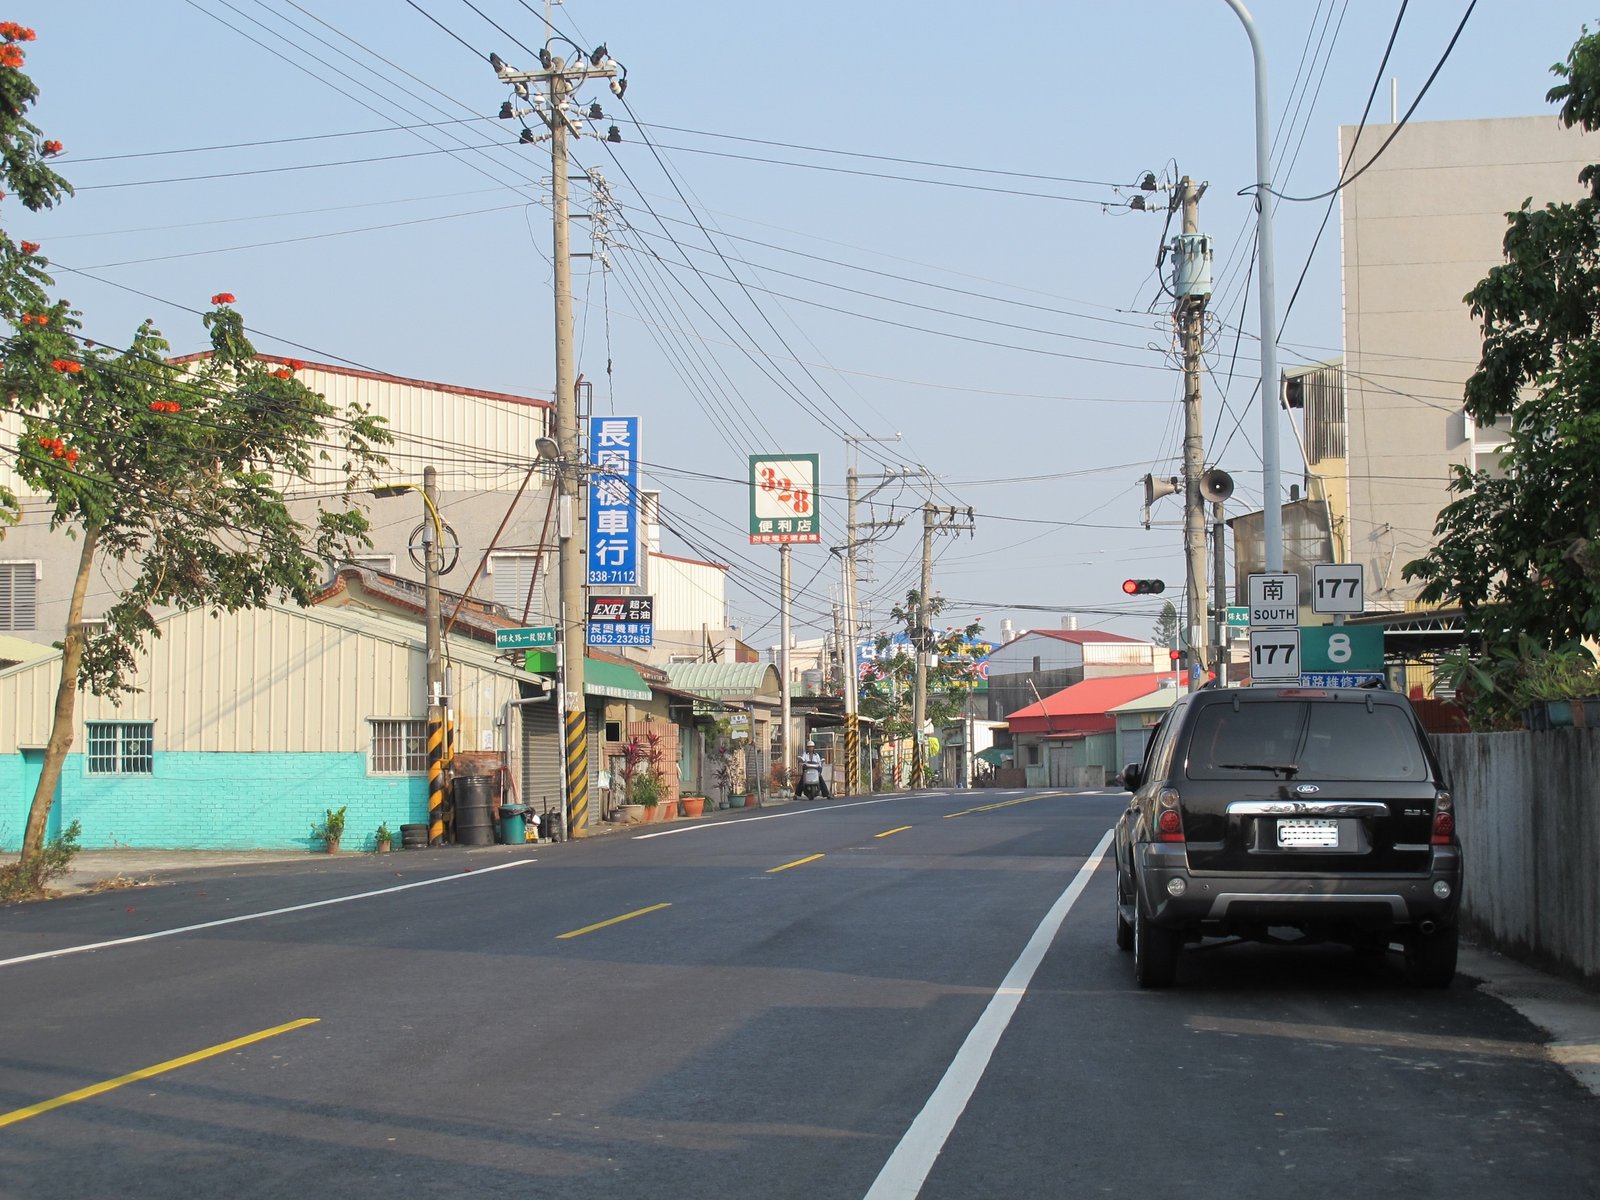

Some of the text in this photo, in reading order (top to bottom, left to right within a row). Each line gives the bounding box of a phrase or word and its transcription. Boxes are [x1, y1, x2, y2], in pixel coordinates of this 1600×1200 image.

[761, 467, 809, 513] 328
[758, 519, 812, 533] 便利店
[589, 571, 635, 583] 338-7112
[1263, 579, 1284, 601] 南
[1316, 578, 1360, 599] 177
[629, 600, 651, 609] 超大
[629, 610, 651, 620] 石油
[1254, 609, 1295, 620] SOUTH
[1254, 644, 1296, 665] 177
[1327, 633, 1352, 664] 8
